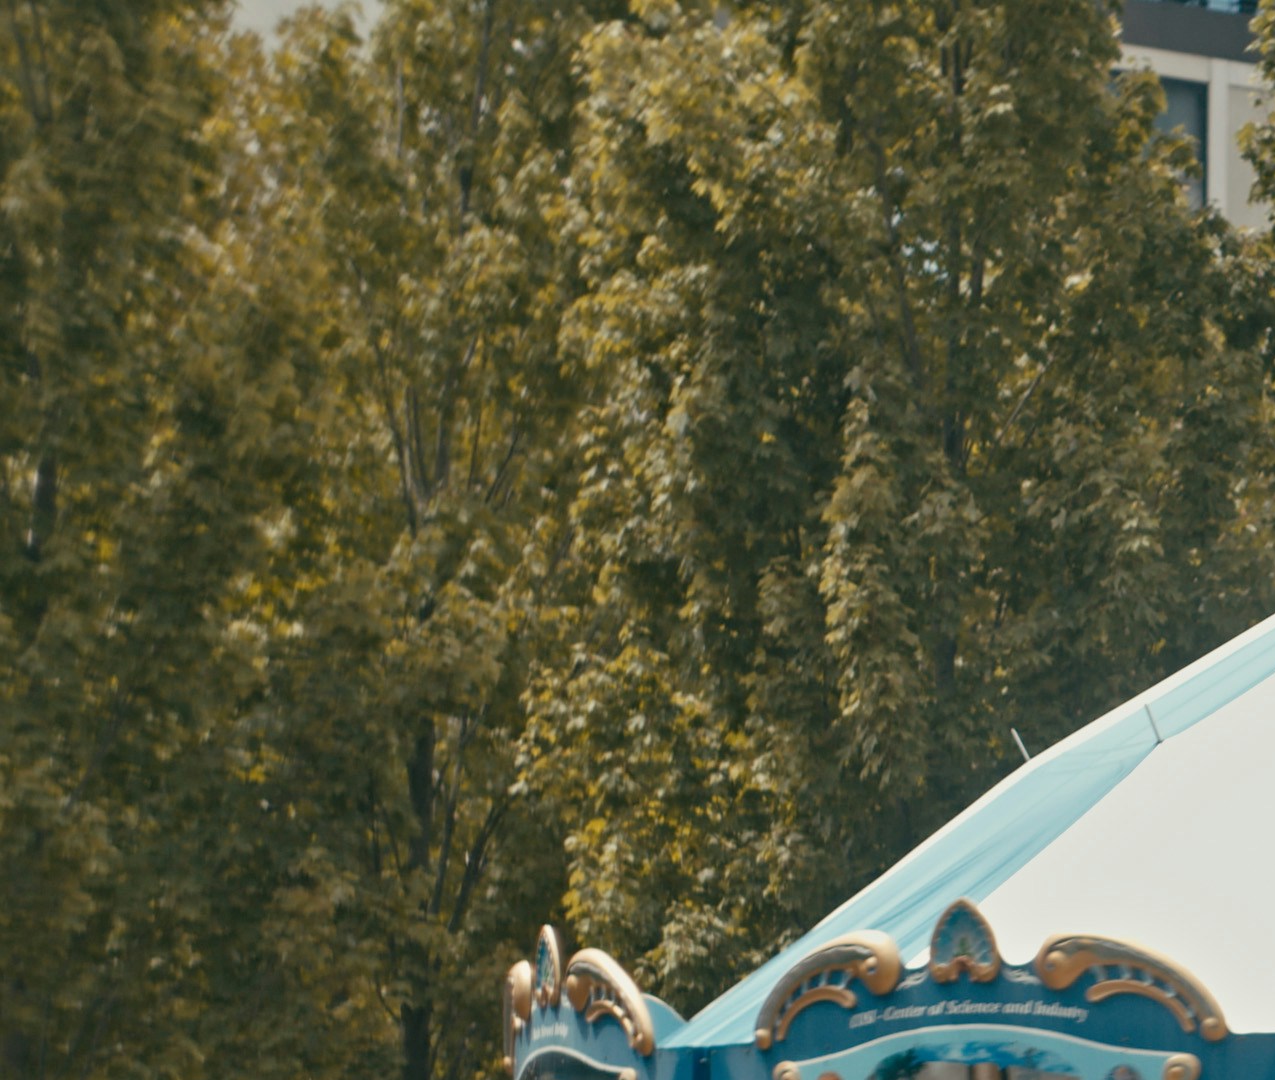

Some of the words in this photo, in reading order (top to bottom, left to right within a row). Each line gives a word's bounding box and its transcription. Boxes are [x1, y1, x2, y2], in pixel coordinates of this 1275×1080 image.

[946, 999, 999, 1014] Science
[1002, 1001, 1032, 1014] and
[1034, 1001, 1088, 1023] Industry
